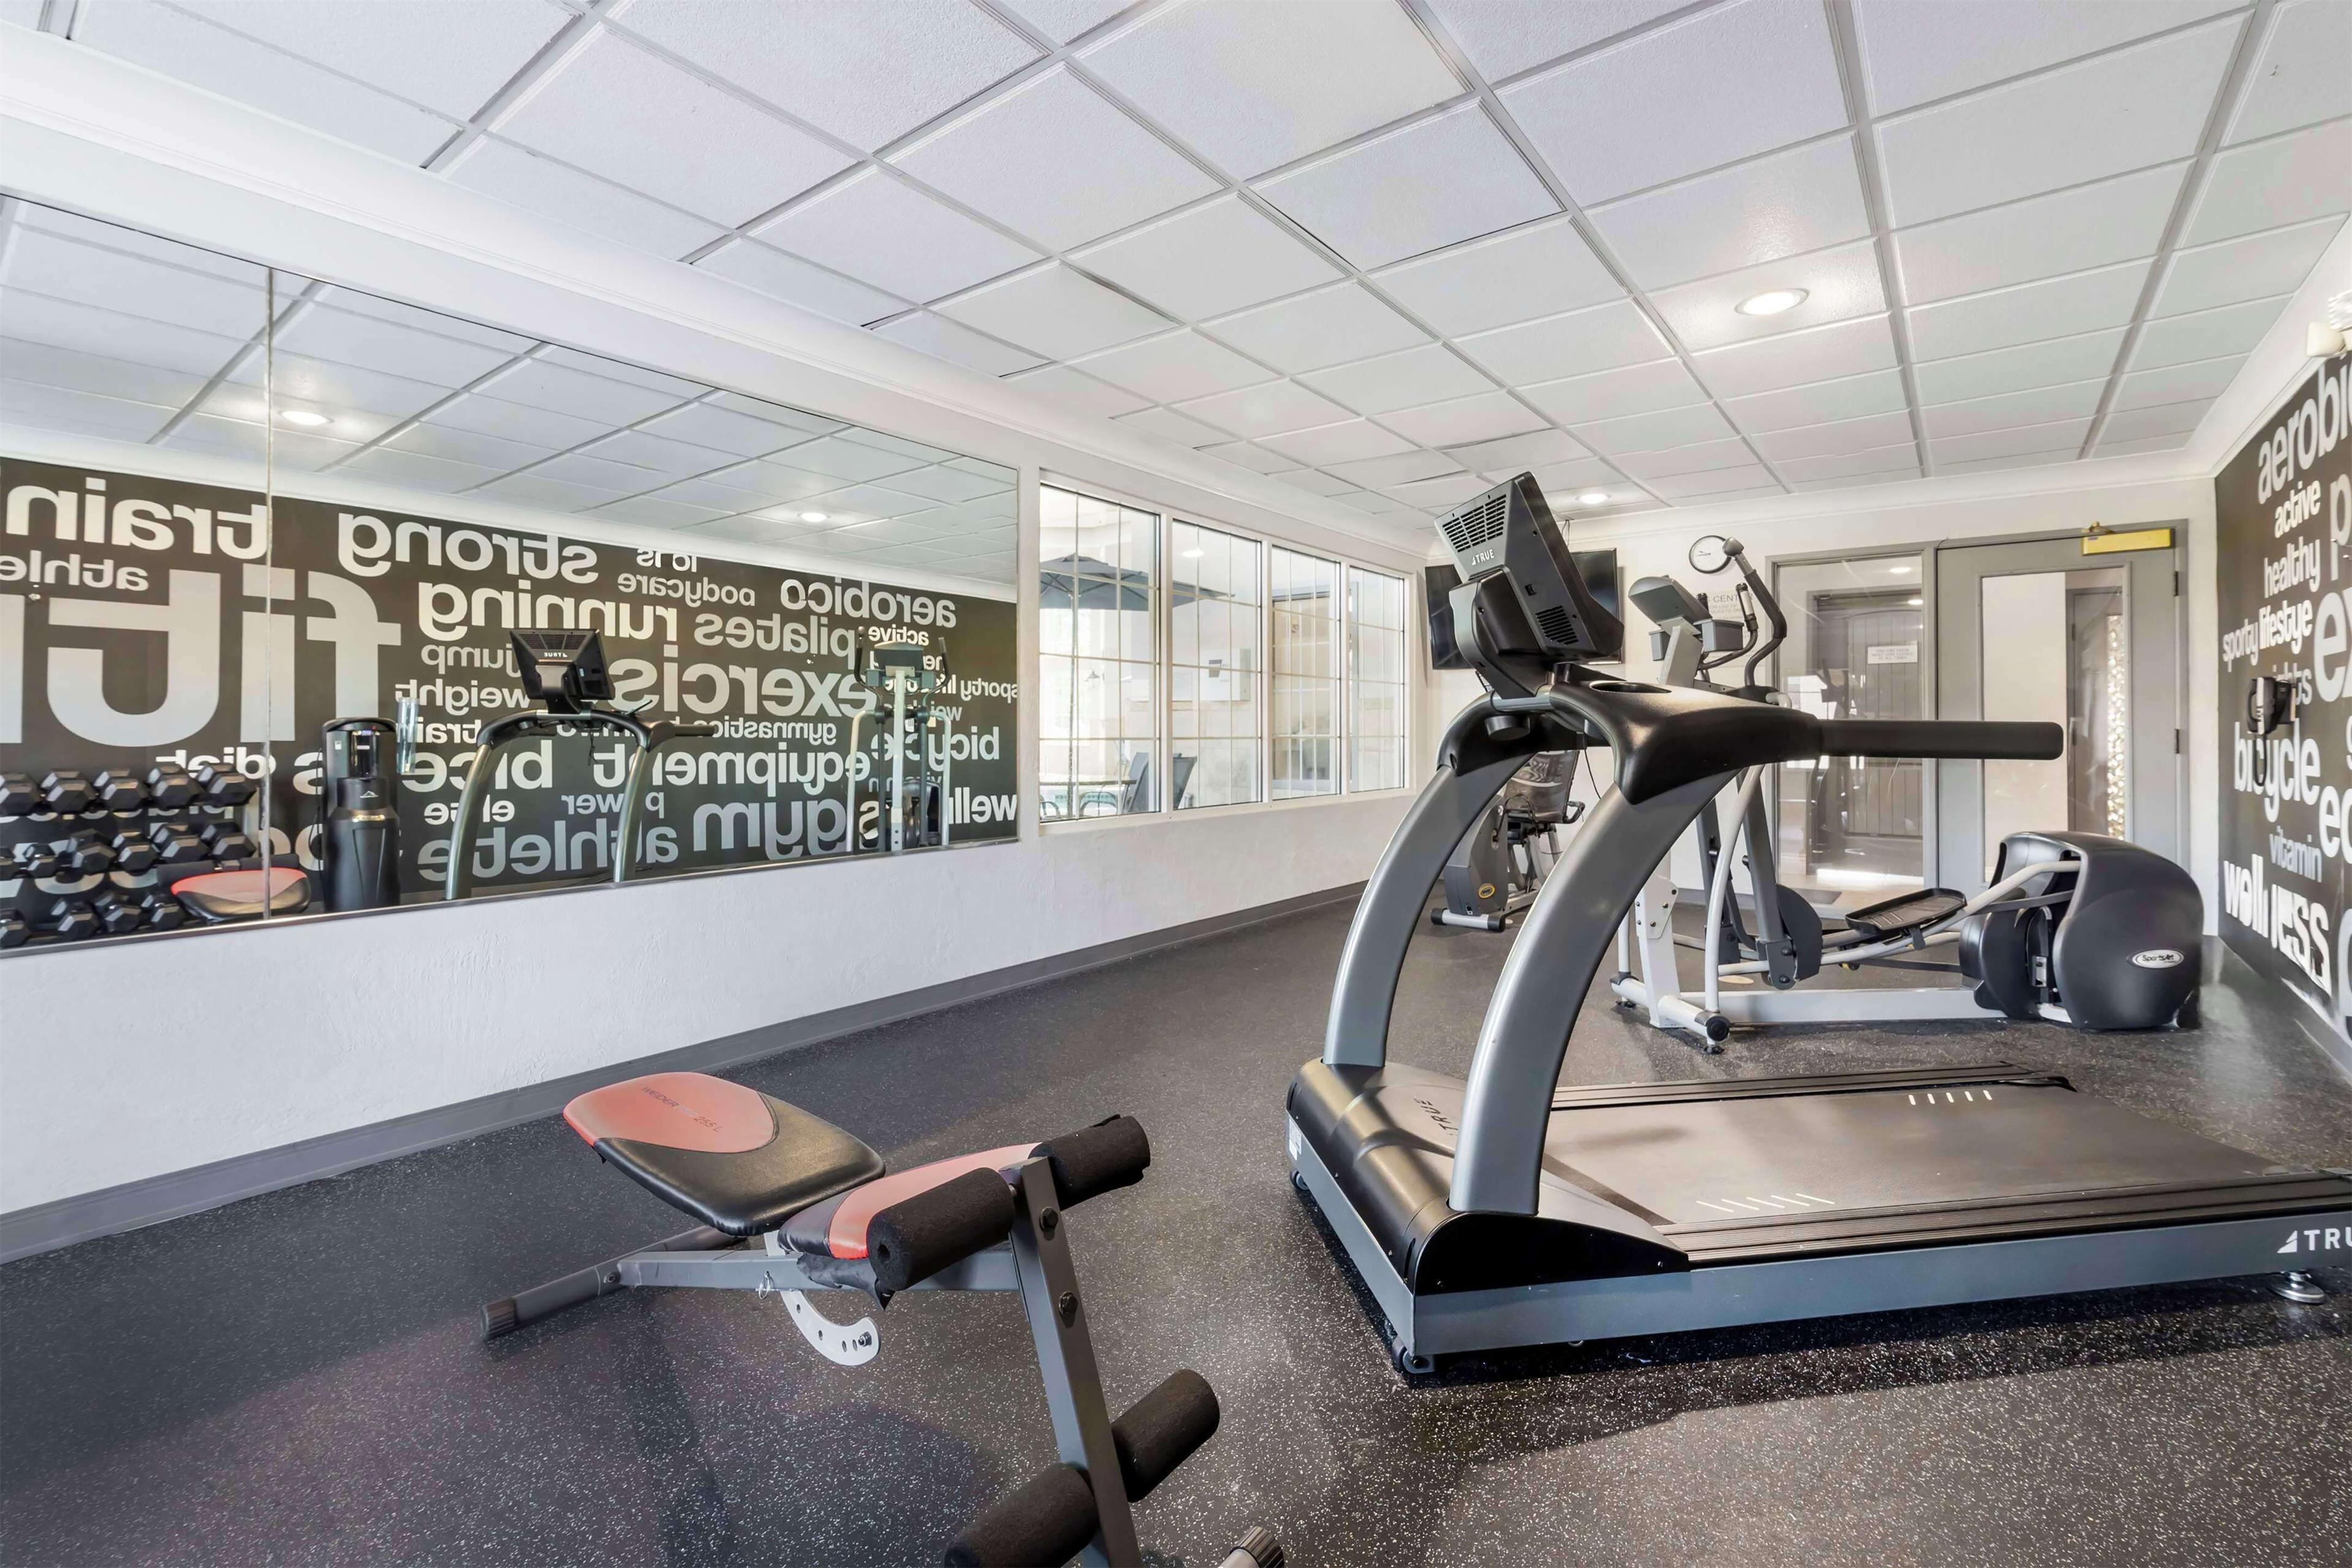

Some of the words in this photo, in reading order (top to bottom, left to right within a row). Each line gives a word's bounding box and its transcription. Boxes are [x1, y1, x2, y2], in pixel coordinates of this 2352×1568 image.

[2257, 352, 2352, 505] aerobi
[2274, 480, 2322, 538] active
[1475, 549, 1494, 564] TRUE
[2264, 536, 2320, 598] healthy
[2223, 617, 2258, 672] sporty
[2233, 717, 2321, 823] bicycle
[2269, 825, 2323, 883] vitamin
